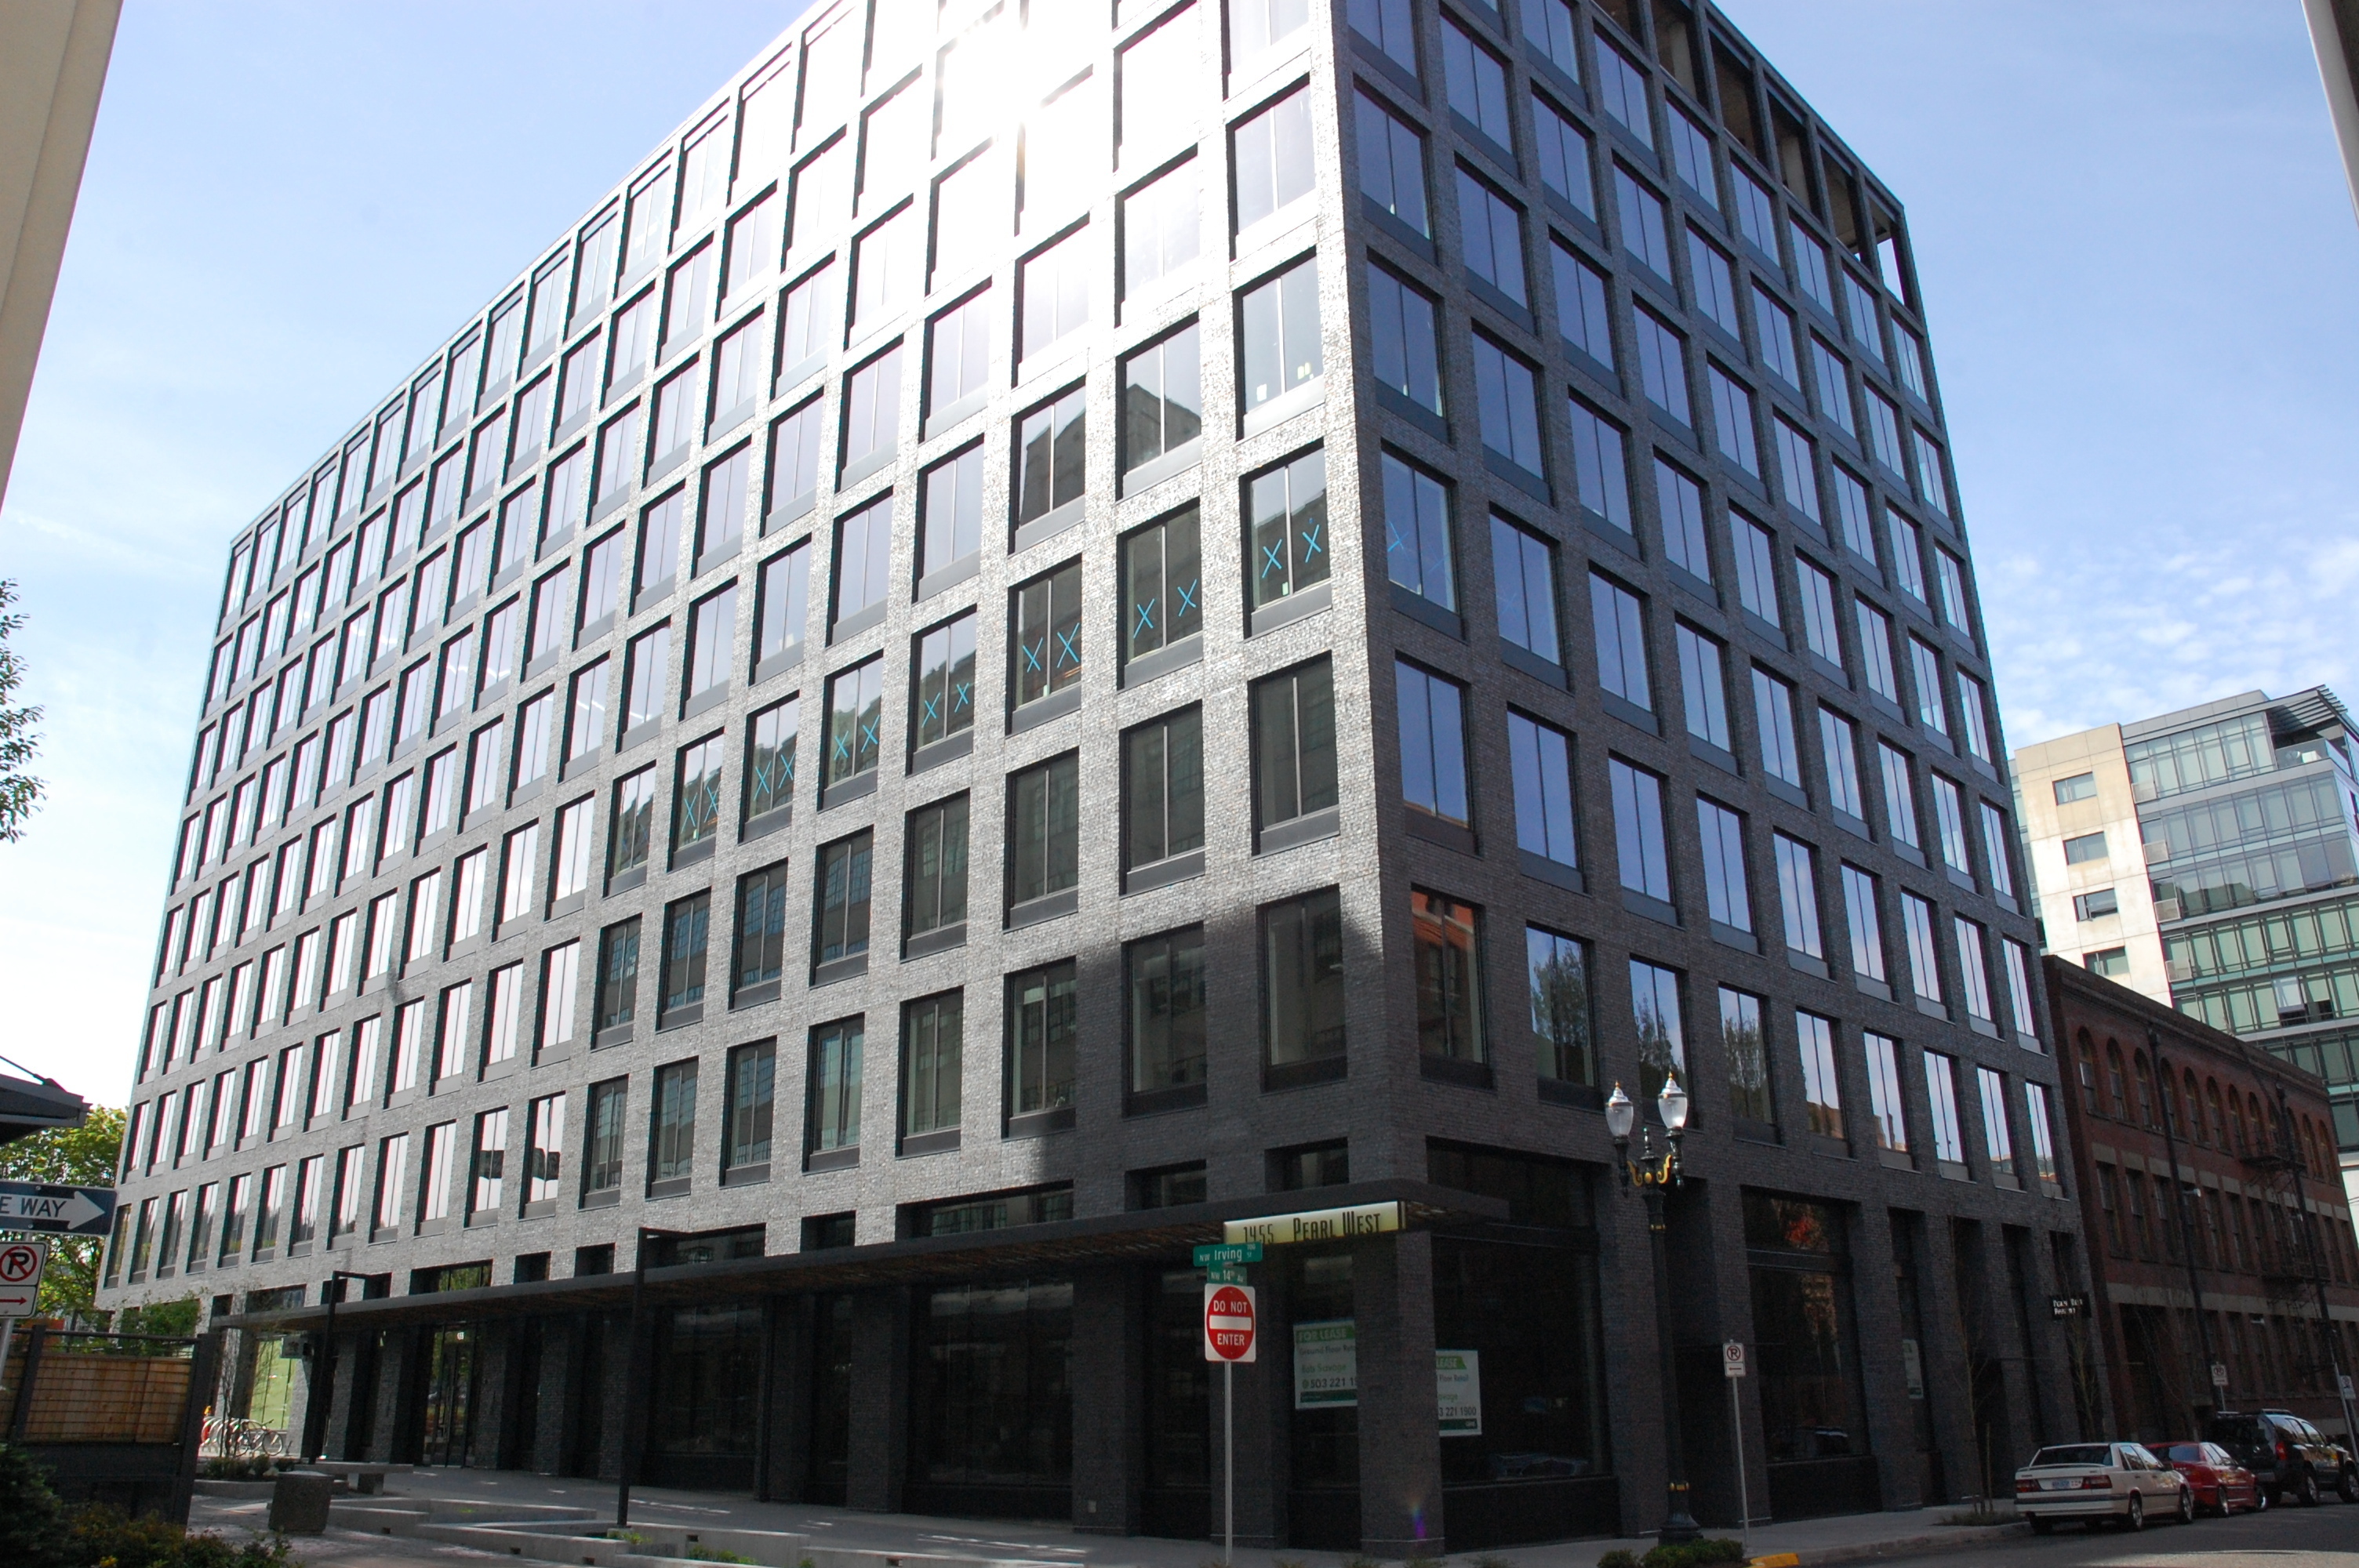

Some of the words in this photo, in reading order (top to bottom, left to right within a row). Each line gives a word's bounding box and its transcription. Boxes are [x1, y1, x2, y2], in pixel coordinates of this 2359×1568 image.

[20, 1197, 67, 1218] WAY
[1244, 1224, 1274, 1244] 1455
[1293, 1217, 1335, 1242] PEARL
[1343, 1210, 1381, 1236] WEST
[1214, 1247, 1242, 1262] Irving
[1211, 1272, 1220, 1280] NW
[1213, 1300, 1226, 1312] DO
[1230, 1301, 1248, 1313] NOT
[1217, 1333, 1245, 1346] ENTER
[1299, 1331, 1318, 1341] FOR
[1319, 1328, 1347, 1340] LEASE
[1436, 1358, 1457, 1368] LEASE
[1310, 1378, 1328, 1388] 503
[1329, 1377, 1345, 1388] 221
[1445, 1406, 1457, 1417] 221
[1460, 1406, 1477, 1416] 1900
